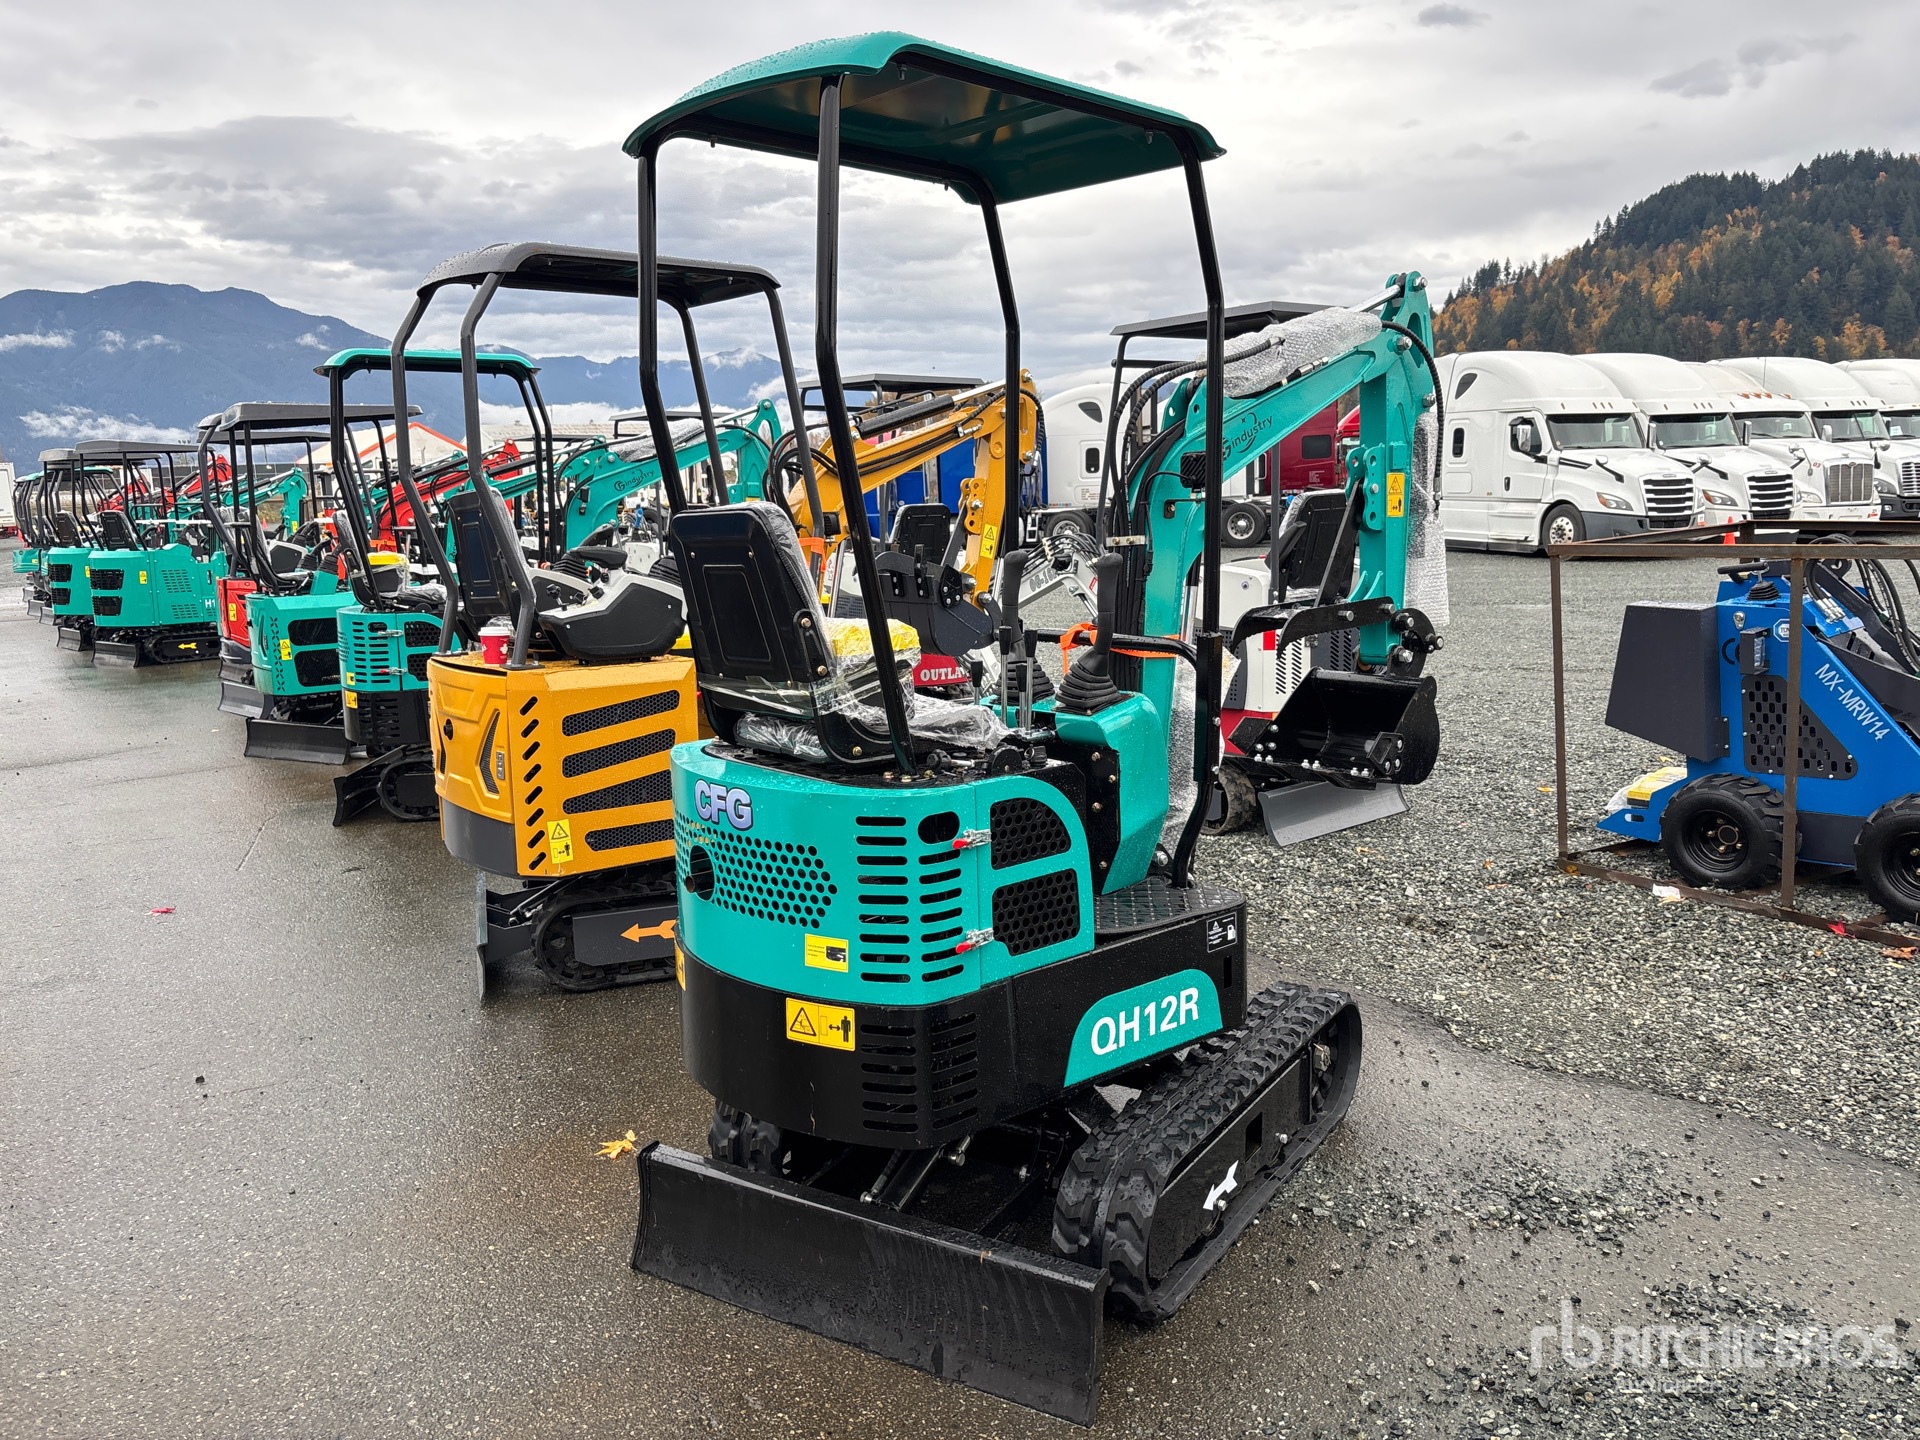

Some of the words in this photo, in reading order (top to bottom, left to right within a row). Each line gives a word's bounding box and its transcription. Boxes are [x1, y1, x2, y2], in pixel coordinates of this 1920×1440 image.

[920, 666, 967, 681] OUTLA
[1815, 663, 1890, 740] MX-MRW14
[695, 779, 753, 831] CFG
[1091, 987, 1199, 1056] QH12R
